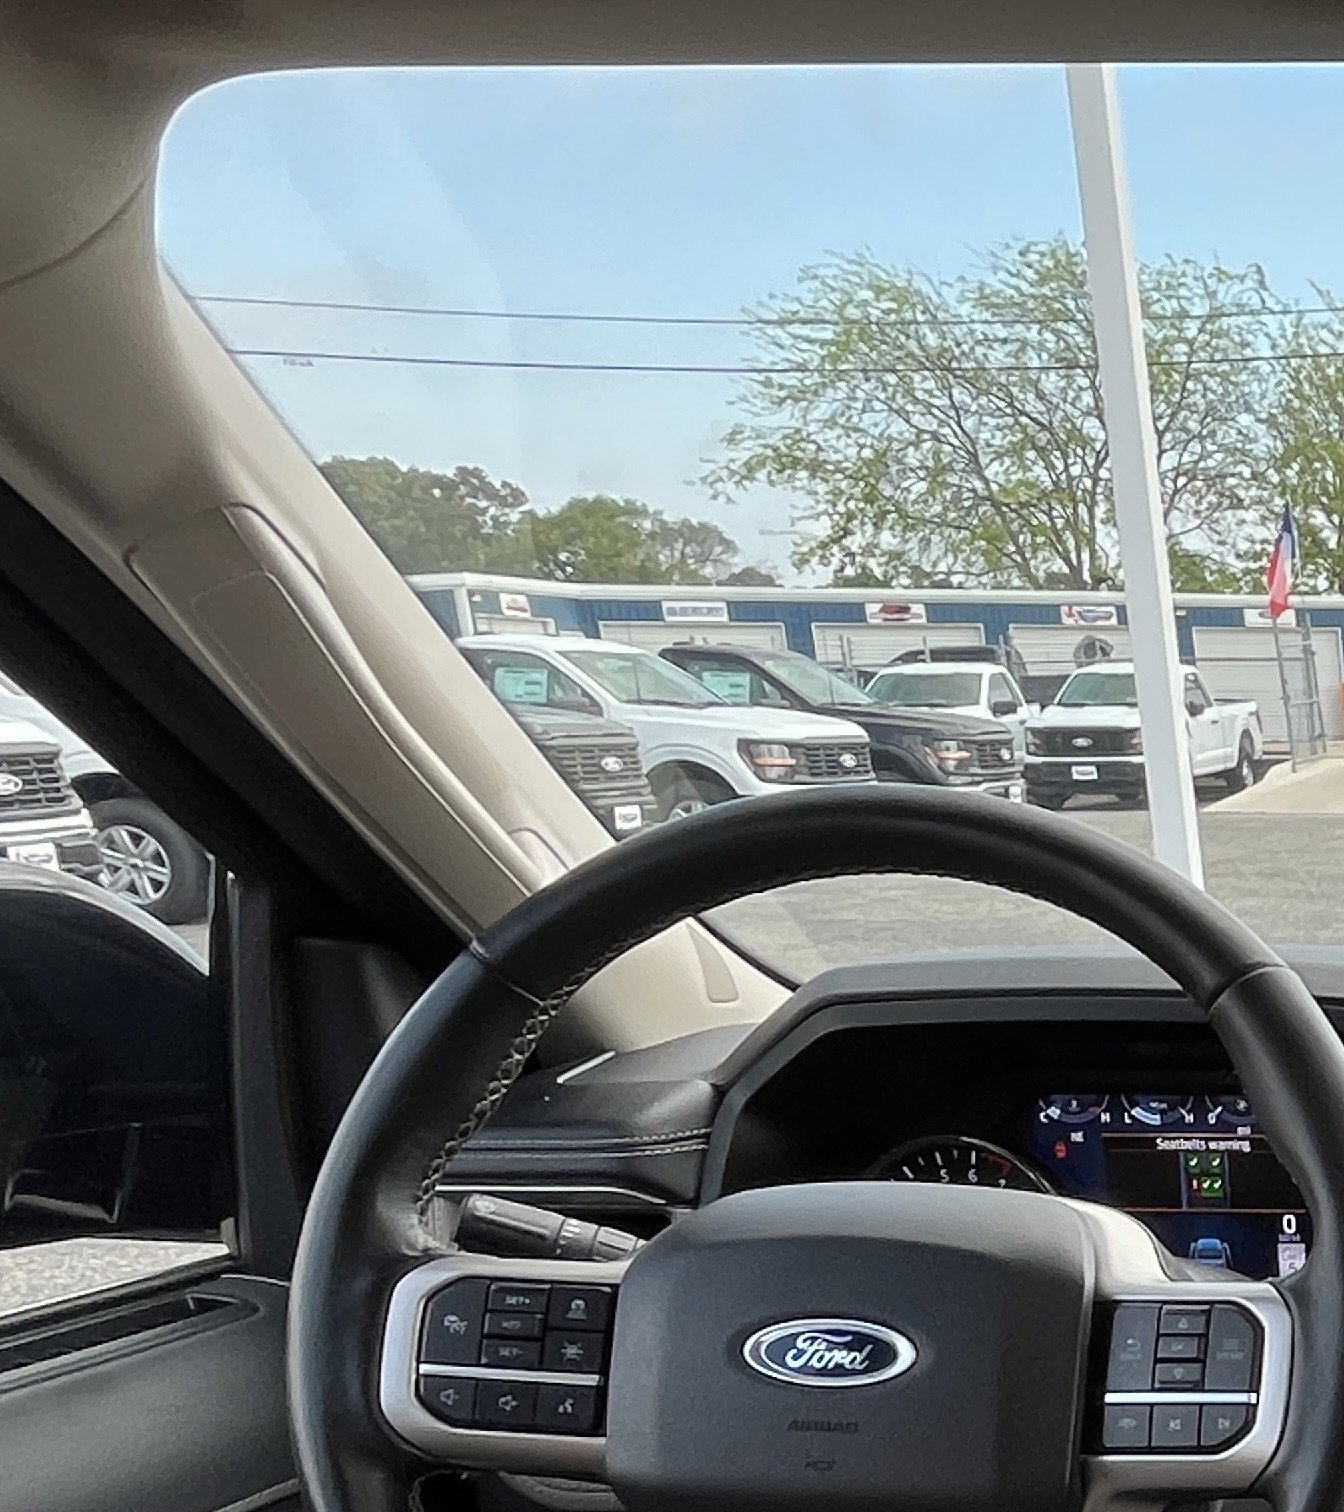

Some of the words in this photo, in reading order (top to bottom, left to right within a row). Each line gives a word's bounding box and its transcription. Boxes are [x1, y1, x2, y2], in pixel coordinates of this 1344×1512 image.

[1101, 1112, 1111, 1123] H
[1156, 1137, 1206, 1150] Seatbelts
[1208, 1139, 1251, 1152] warning
[940, 1168, 950, 1183] 5
[968, 1168, 978, 1183] 6
[1282, 1214, 1296, 1234] 0
[784, 1332, 874, 1370] Ford
